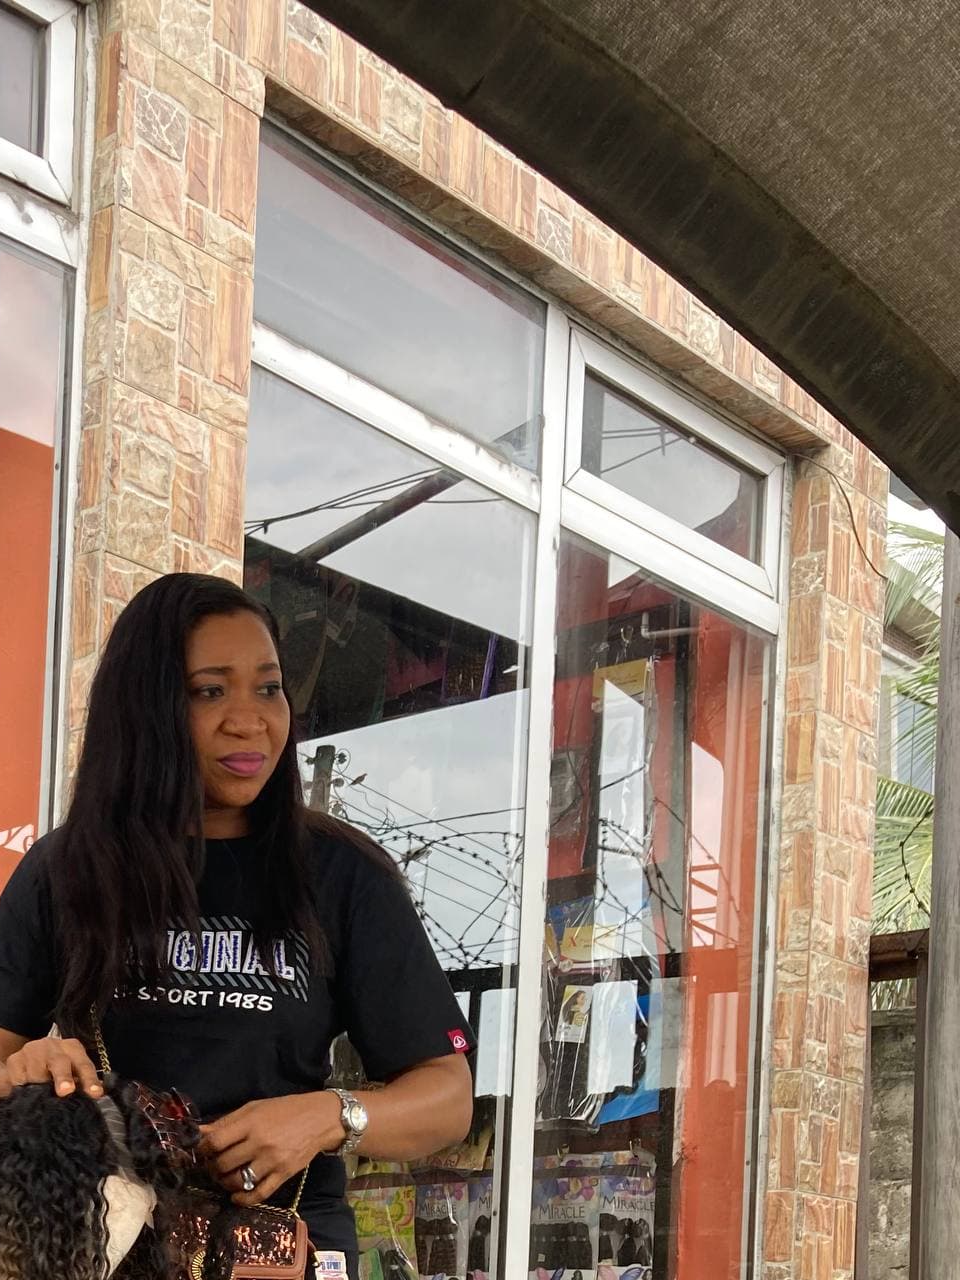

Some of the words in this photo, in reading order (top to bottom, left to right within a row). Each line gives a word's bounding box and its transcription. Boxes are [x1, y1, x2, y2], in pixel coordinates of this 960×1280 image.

[218, 991, 274, 1012] 1985
[538, 1202, 585, 1219] MIRACLE
[602, 1195, 655, 1212] MIRACLE
